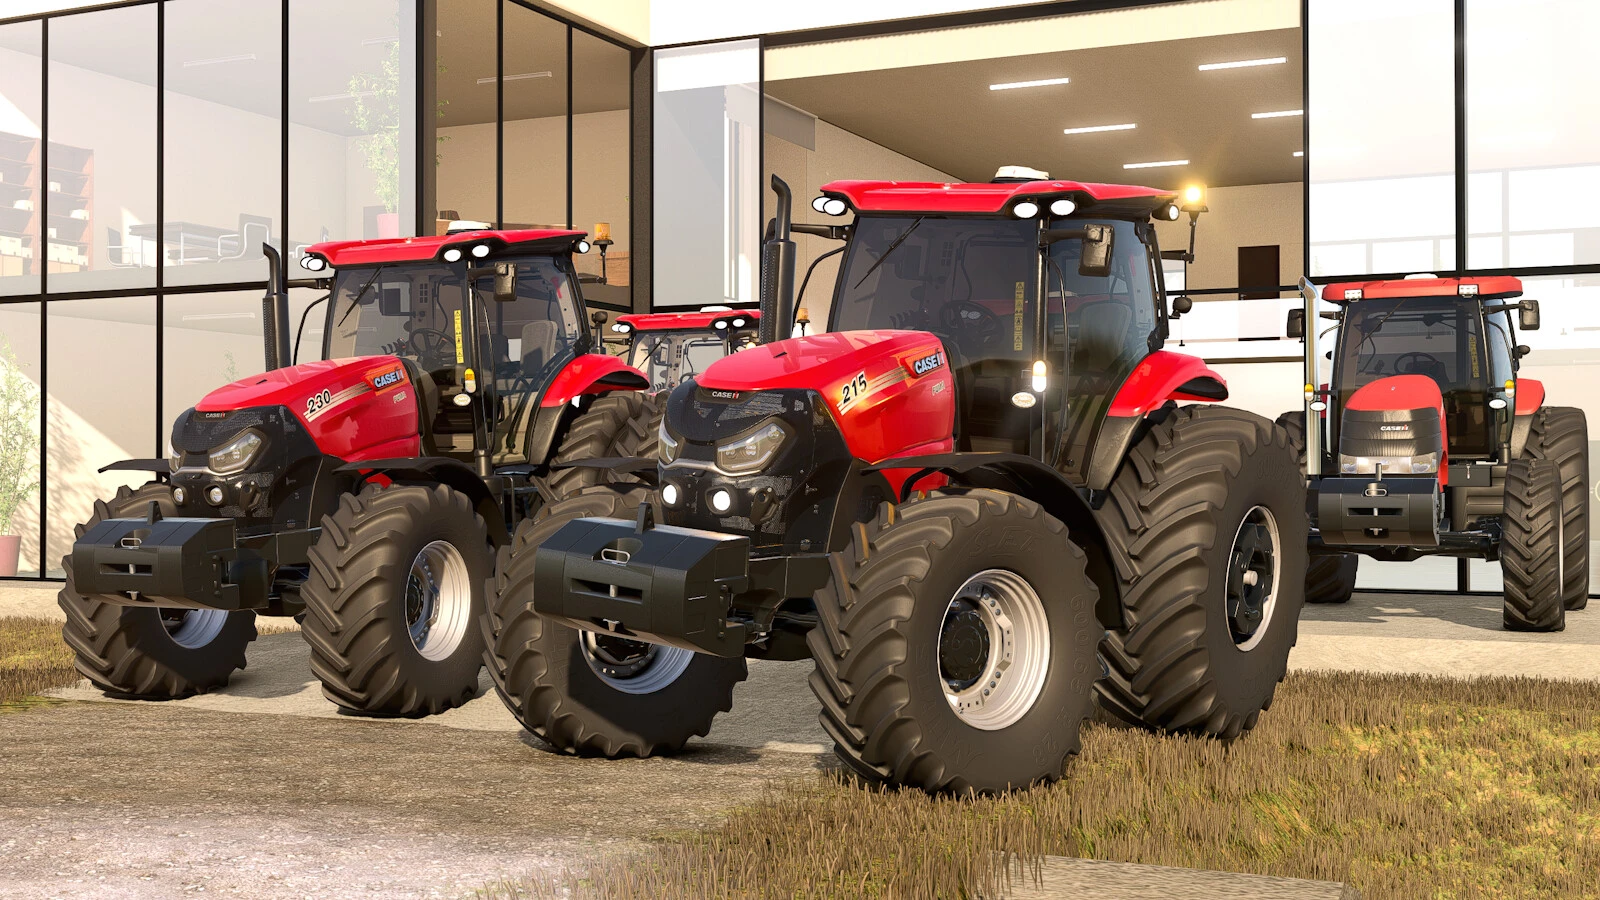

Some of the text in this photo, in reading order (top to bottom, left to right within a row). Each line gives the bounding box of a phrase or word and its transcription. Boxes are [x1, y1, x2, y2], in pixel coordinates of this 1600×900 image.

[915, 355, 937, 374] CASE
[374, 373, 397, 387] CASE
[841, 371, 868, 404] 215
[307, 389, 331, 414] 230
